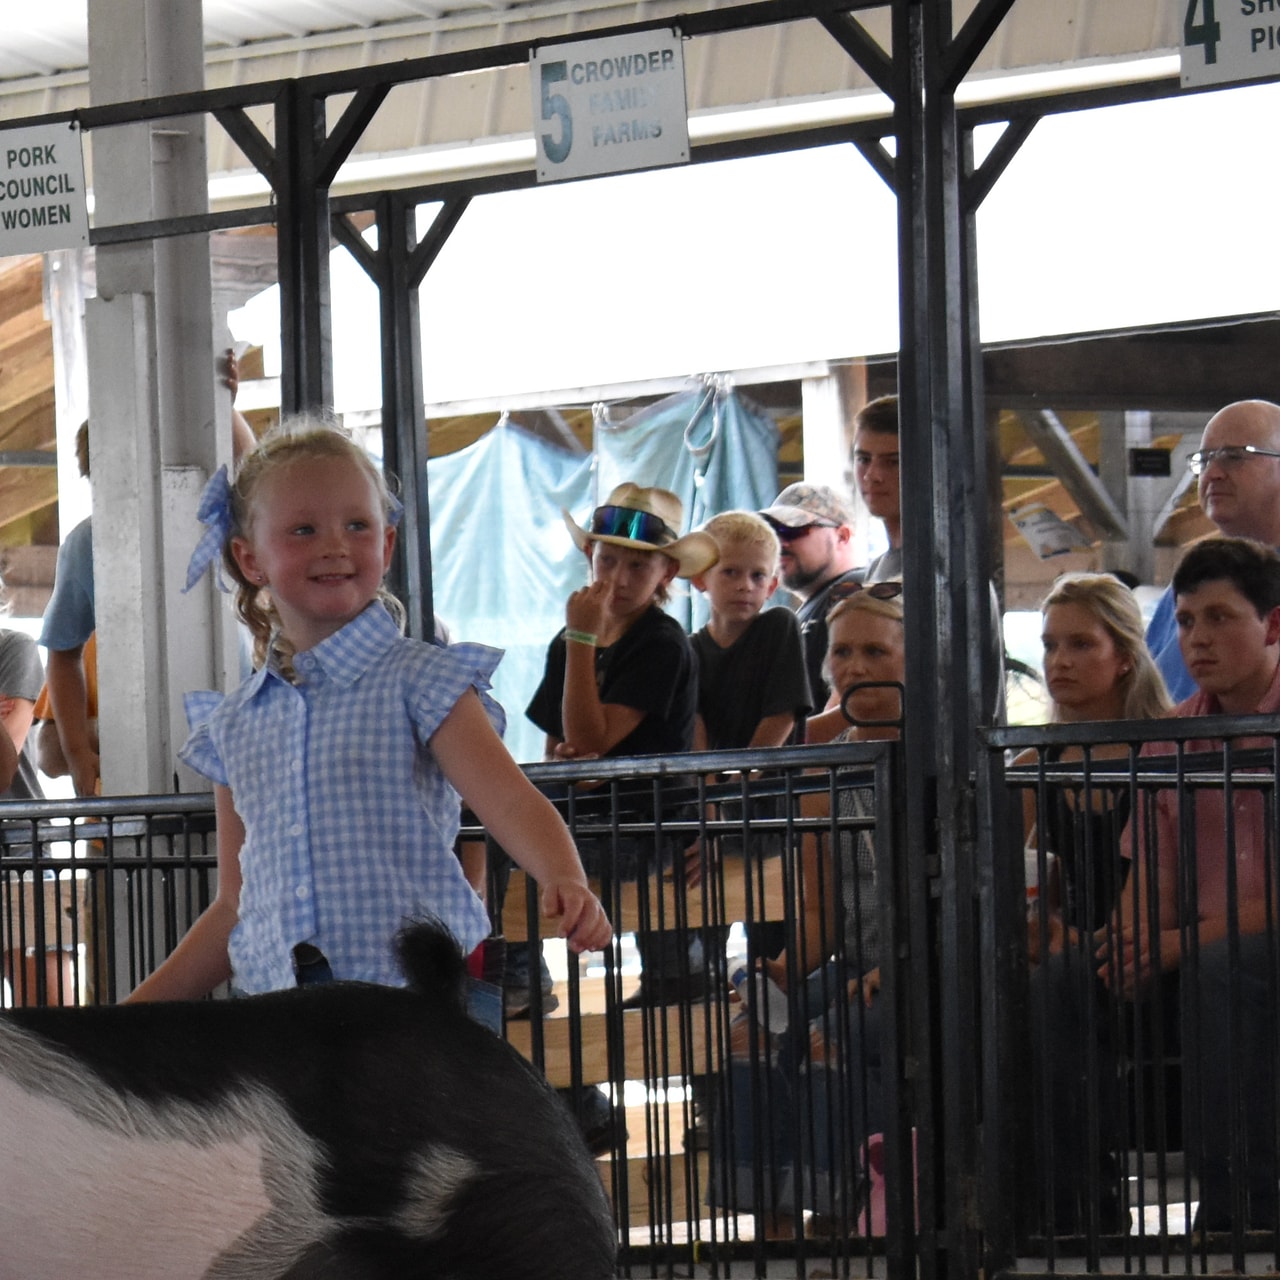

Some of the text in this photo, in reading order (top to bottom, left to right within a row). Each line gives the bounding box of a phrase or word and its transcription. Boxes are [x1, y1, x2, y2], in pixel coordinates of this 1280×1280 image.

[1240, 0, 1280, 16] SH
[1183, 0, 1221, 65] 4
[1251, 25, 1280, 53] PI
[571, 49, 675, 85] CROWDER
[541, 60, 573, 164] 5
[589, 84, 658, 116] FAMIL
[592, 119, 662, 147] FARMS
[7, 144, 57, 169] PORK
[1, 204, 71, 230] WOMEN
